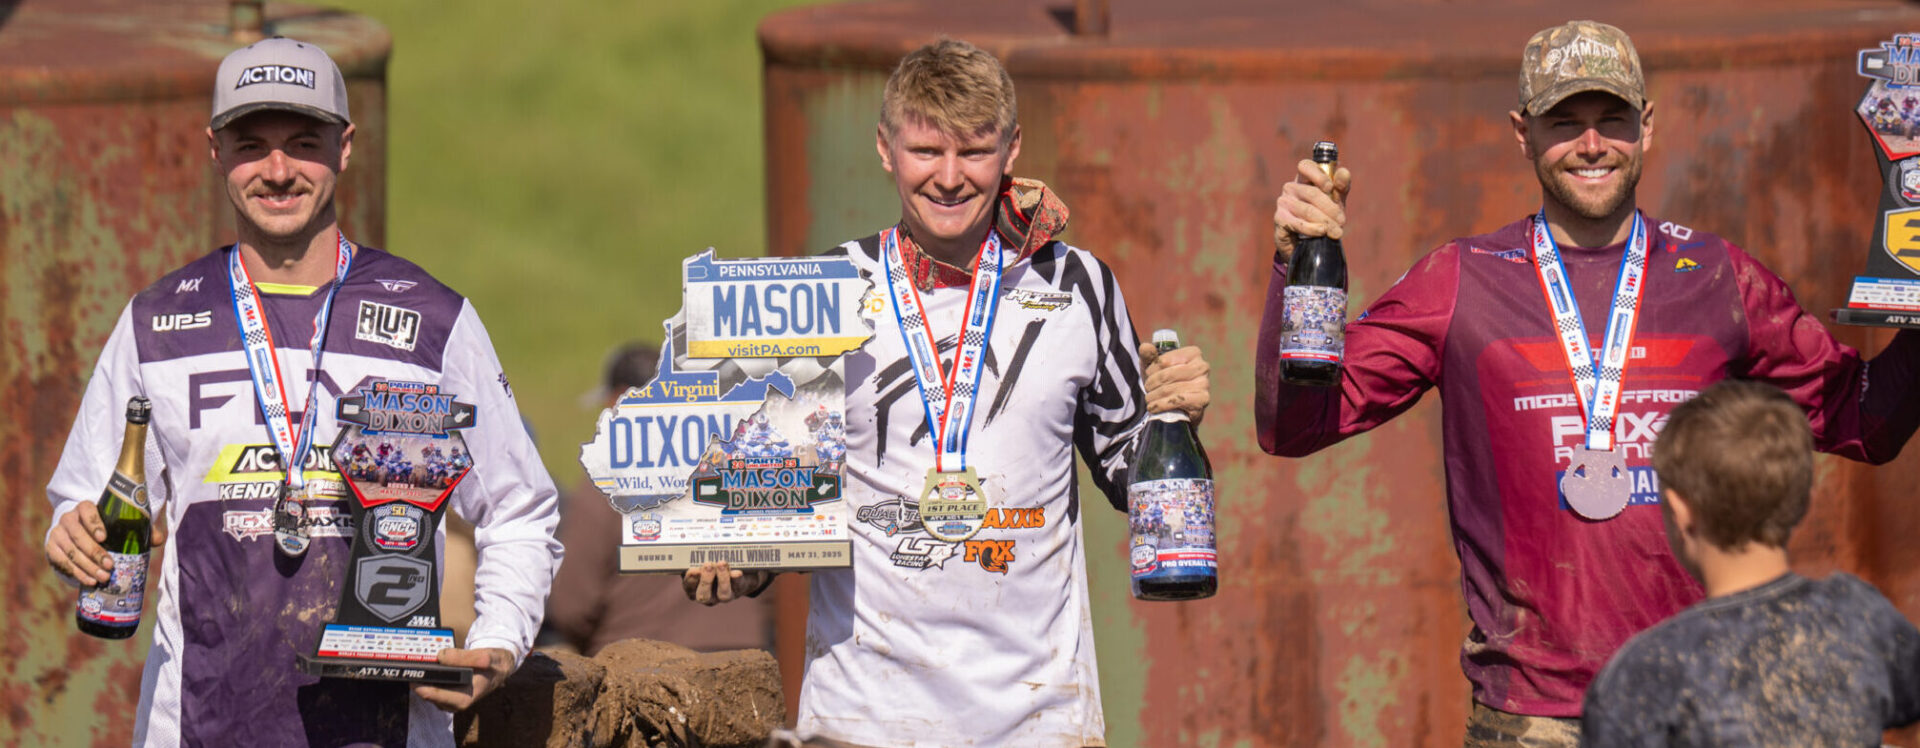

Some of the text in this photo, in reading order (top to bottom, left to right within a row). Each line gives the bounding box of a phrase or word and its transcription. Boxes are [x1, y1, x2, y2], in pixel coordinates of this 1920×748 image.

[238, 65, 309, 87] ACTION
[719, 263, 823, 278] PENNSYLVANIA
[175, 276, 204, 293] MX
[712, 282, 841, 337] MASON
[152, 311, 212, 331] WPS
[727, 343, 821, 357] visitPA.com
[365, 392, 451, 414] MASON
[371, 411, 445, 433] DIXON
[236, 447, 333, 473] ACON
[732, 460, 745, 469] 20
[785, 459, 797, 468] 25
[615, 476, 653, 490] Wild,
[722, 469, 813, 489] MASON
[731, 489, 806, 508] DIXON
[391, 505, 406, 516] 50
[947, 504, 979, 512] PLACE
[981, 507, 1046, 529] AXXIS
[690, 548, 781, 564] ATV OVERALL WINNER
[788, 552, 806, 560] MAY
[964, 538, 1016, 570] FOX
[1178, 559, 1207, 567] OVERALL
[406, 615, 437, 628] AMA
[357, 667, 381, 677] ATV
[402, 669, 425, 679] PRO
